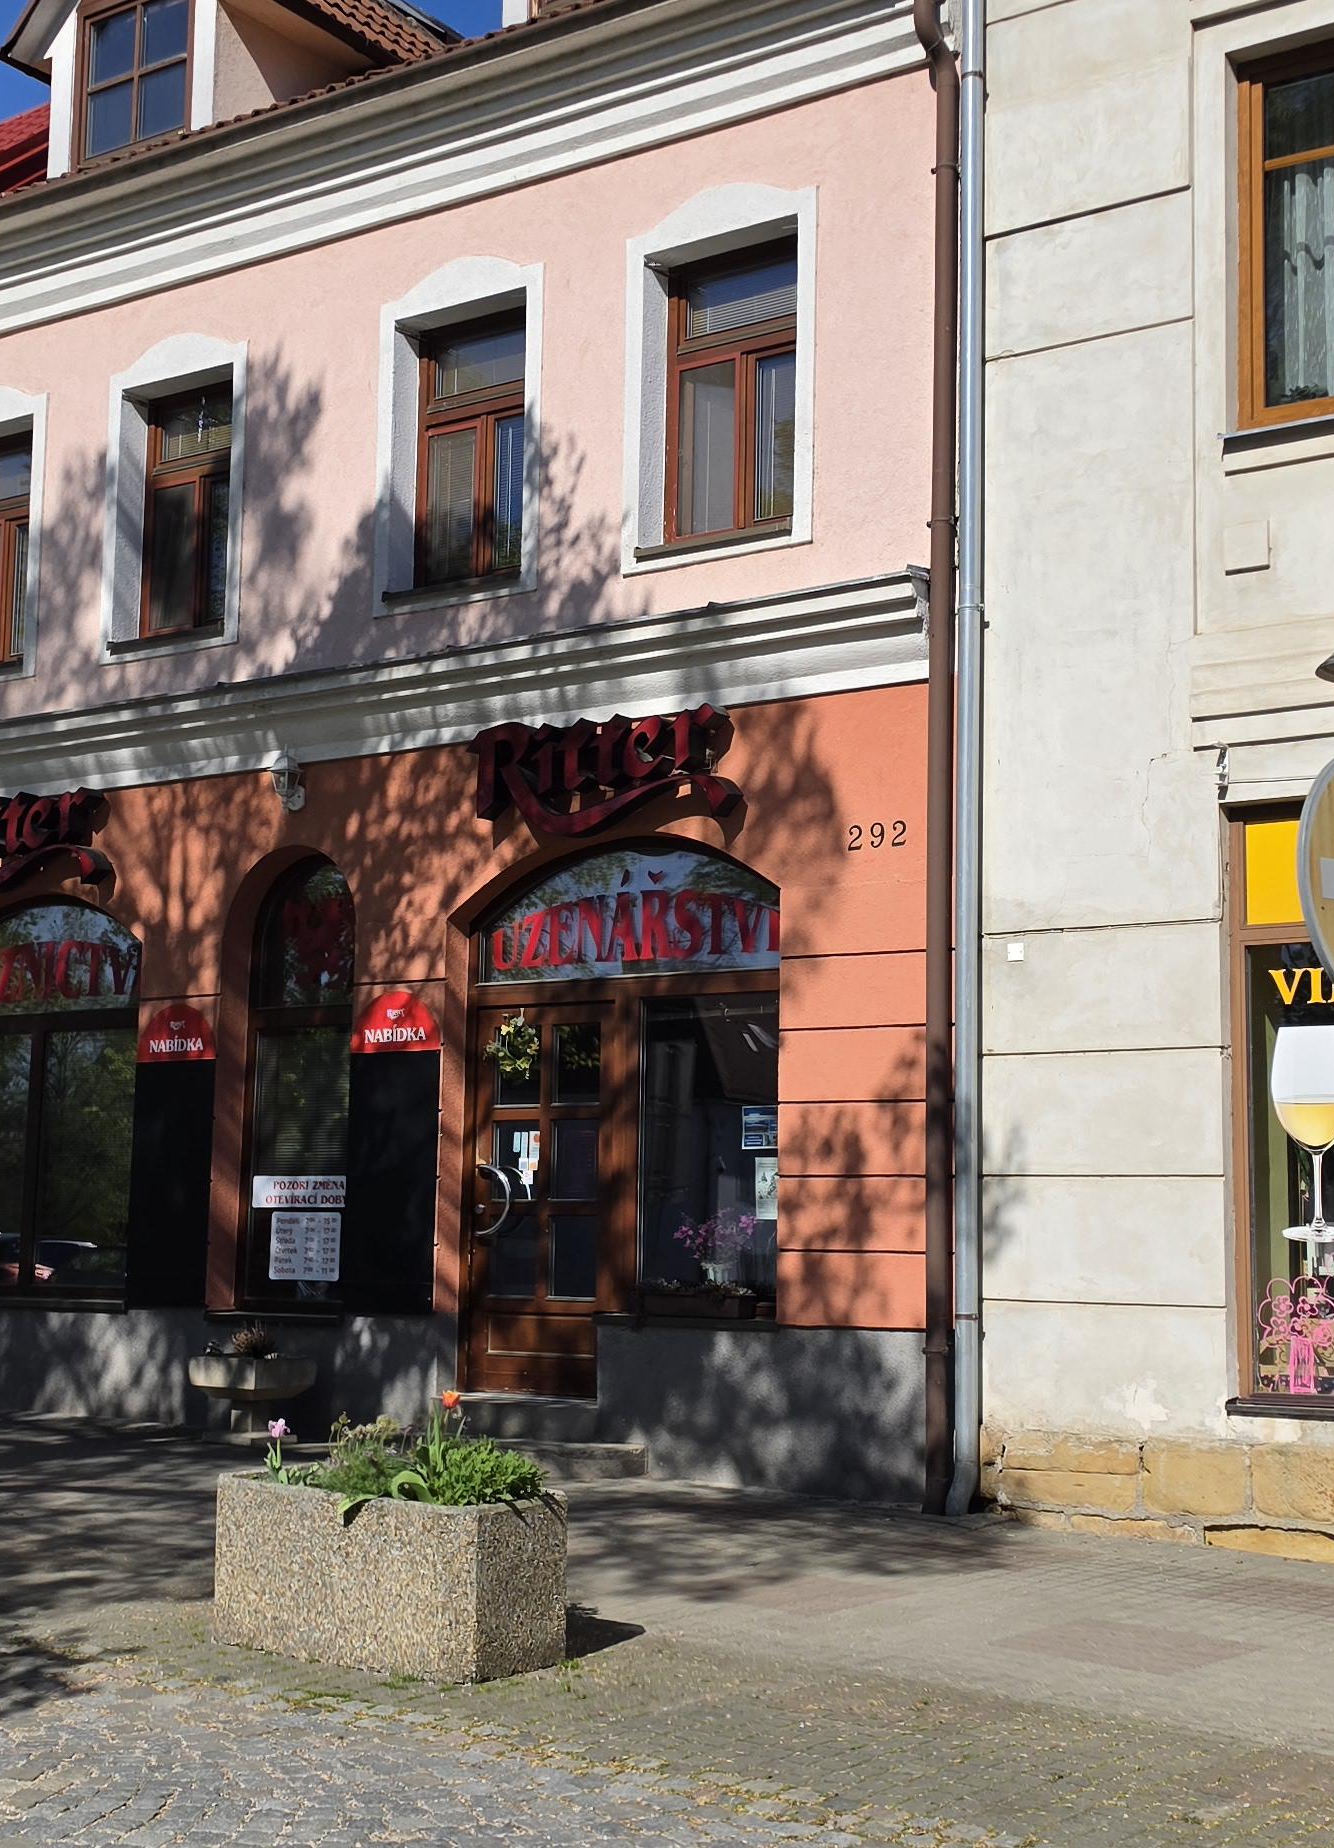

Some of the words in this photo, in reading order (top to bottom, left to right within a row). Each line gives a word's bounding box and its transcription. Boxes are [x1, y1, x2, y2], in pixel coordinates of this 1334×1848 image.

[470, 702, 733, 837] Ritter
[848, 820, 907, 851] 292
[149, 1035, 204, 1053] NABÍDKA
[364, 1024, 427, 1044] NABÍDKA
[265, 1193, 318, 1204] OTEVÍRACÍ
